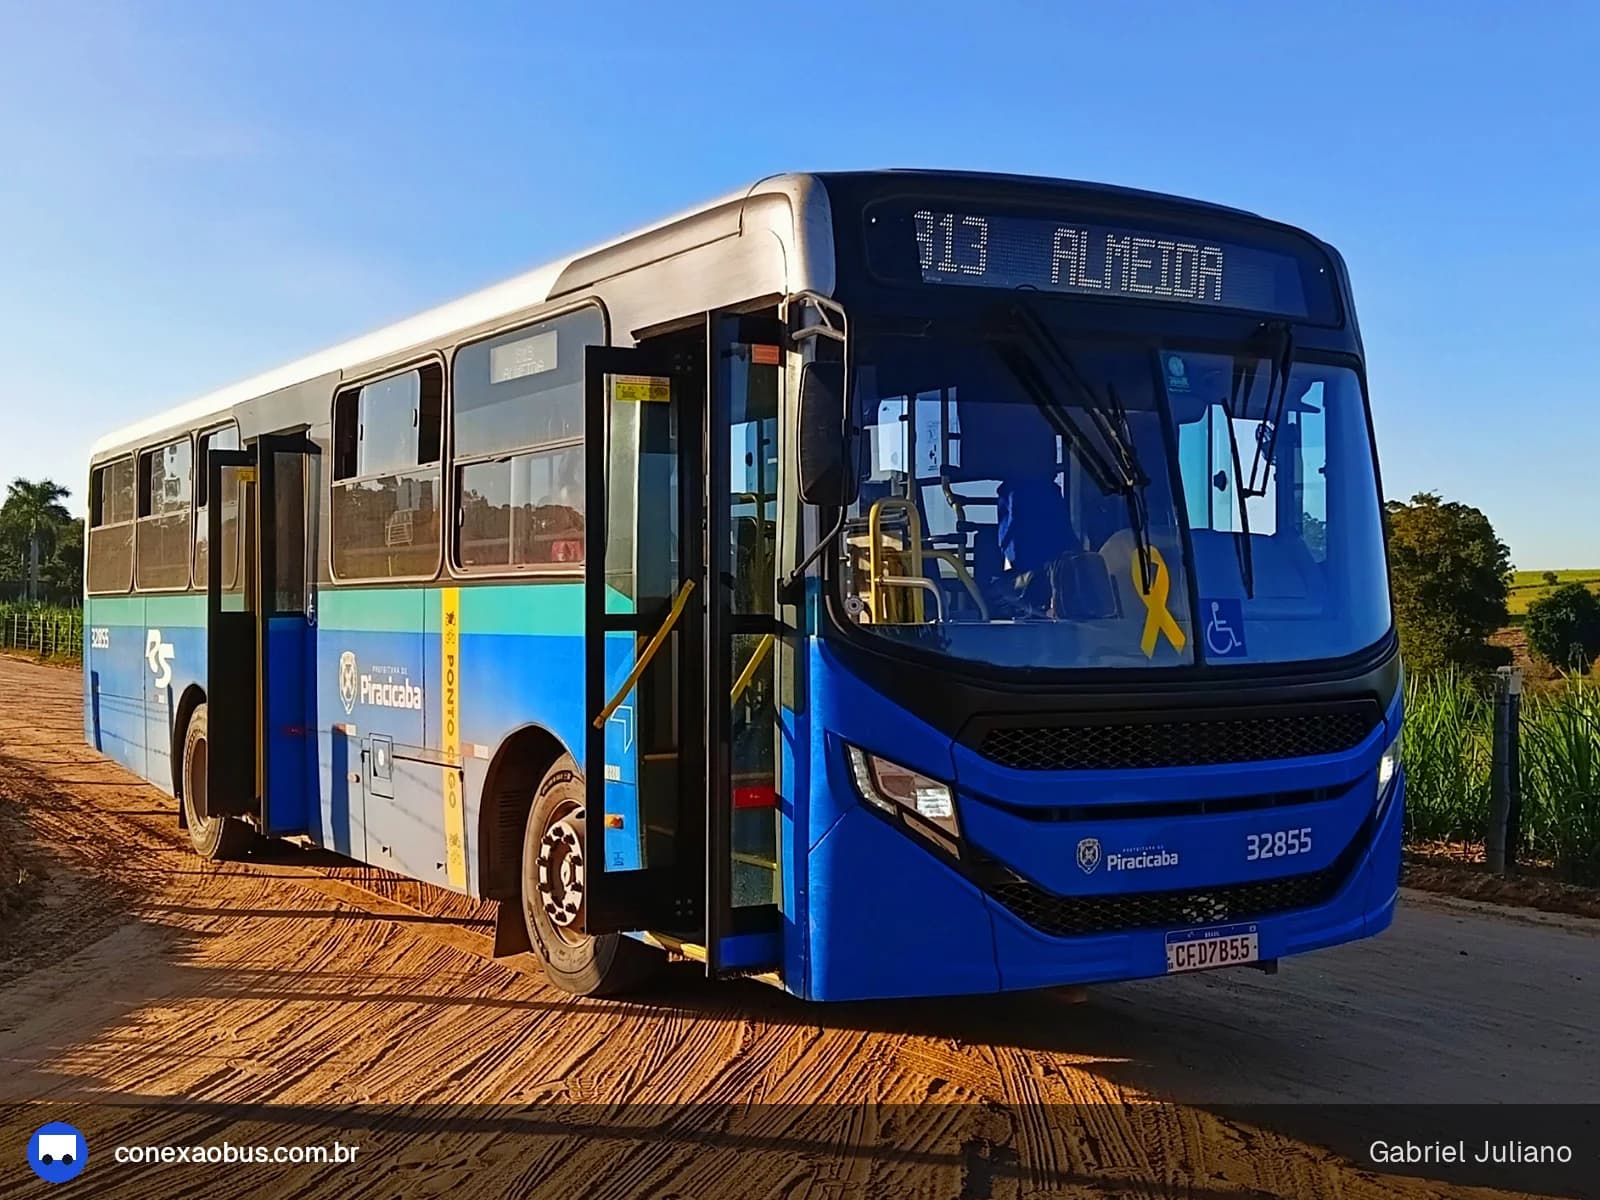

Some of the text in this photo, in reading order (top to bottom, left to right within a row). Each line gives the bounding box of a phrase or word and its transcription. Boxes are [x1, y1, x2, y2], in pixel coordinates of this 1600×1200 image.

[1050, 226, 1225, 302] ALMEIDA
[360, 674, 422, 710] Piracicaba
[446, 654, 455, 737] PONTO
[1106, 850, 1179, 872] Piracicaba
[1246, 827, 1312, 861] 32855
[1175, 937, 1250, 968] CFD7B55
